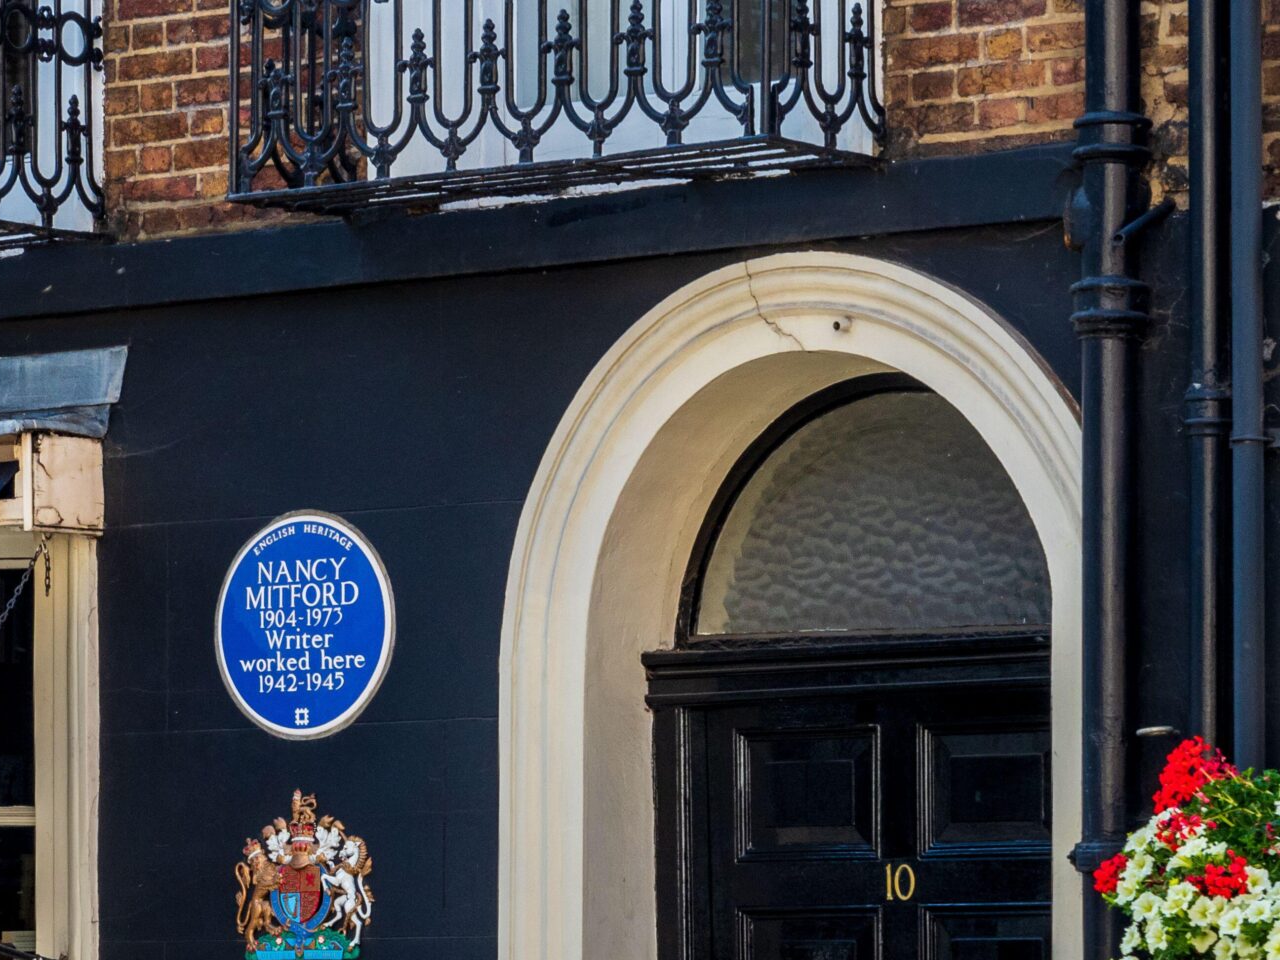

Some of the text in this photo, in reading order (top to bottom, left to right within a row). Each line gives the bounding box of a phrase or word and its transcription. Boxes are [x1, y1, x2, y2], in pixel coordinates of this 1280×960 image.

[253, 524, 353, 556] ENGLISH HERITAGE
[257, 556, 347, 584] NANCY
[245, 581, 359, 610] MITFORD
[259, 607, 343, 629] 1904-1973
[265, 628, 334, 650] Writer
[240, 649, 366, 673] worked here
[258, 672, 345, 693] 1942-1945
[886, 863, 916, 901] 10
